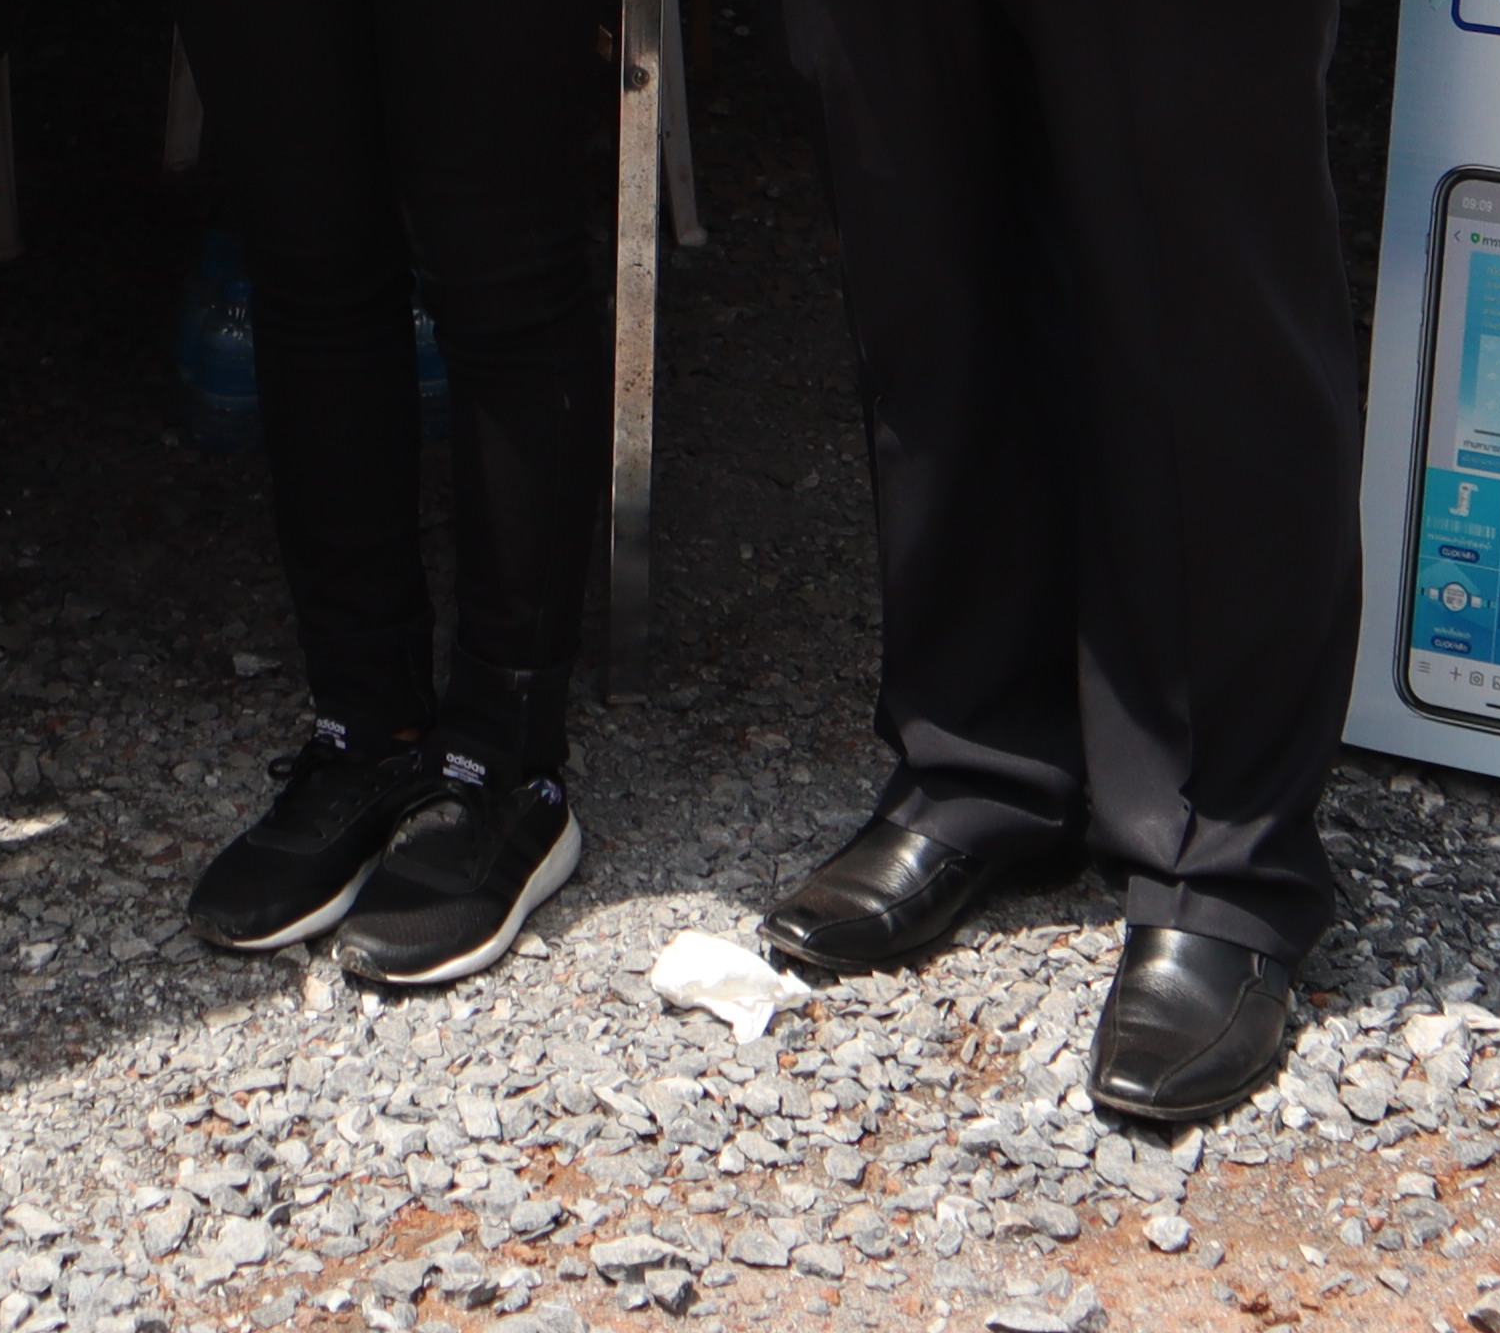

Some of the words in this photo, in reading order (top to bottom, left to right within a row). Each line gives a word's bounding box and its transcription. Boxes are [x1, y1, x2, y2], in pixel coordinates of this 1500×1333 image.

[1462, 196, 1493, 213] 09:09
[315, 718, 347, 736] adidas
[445, 751, 487, 776] adidas
